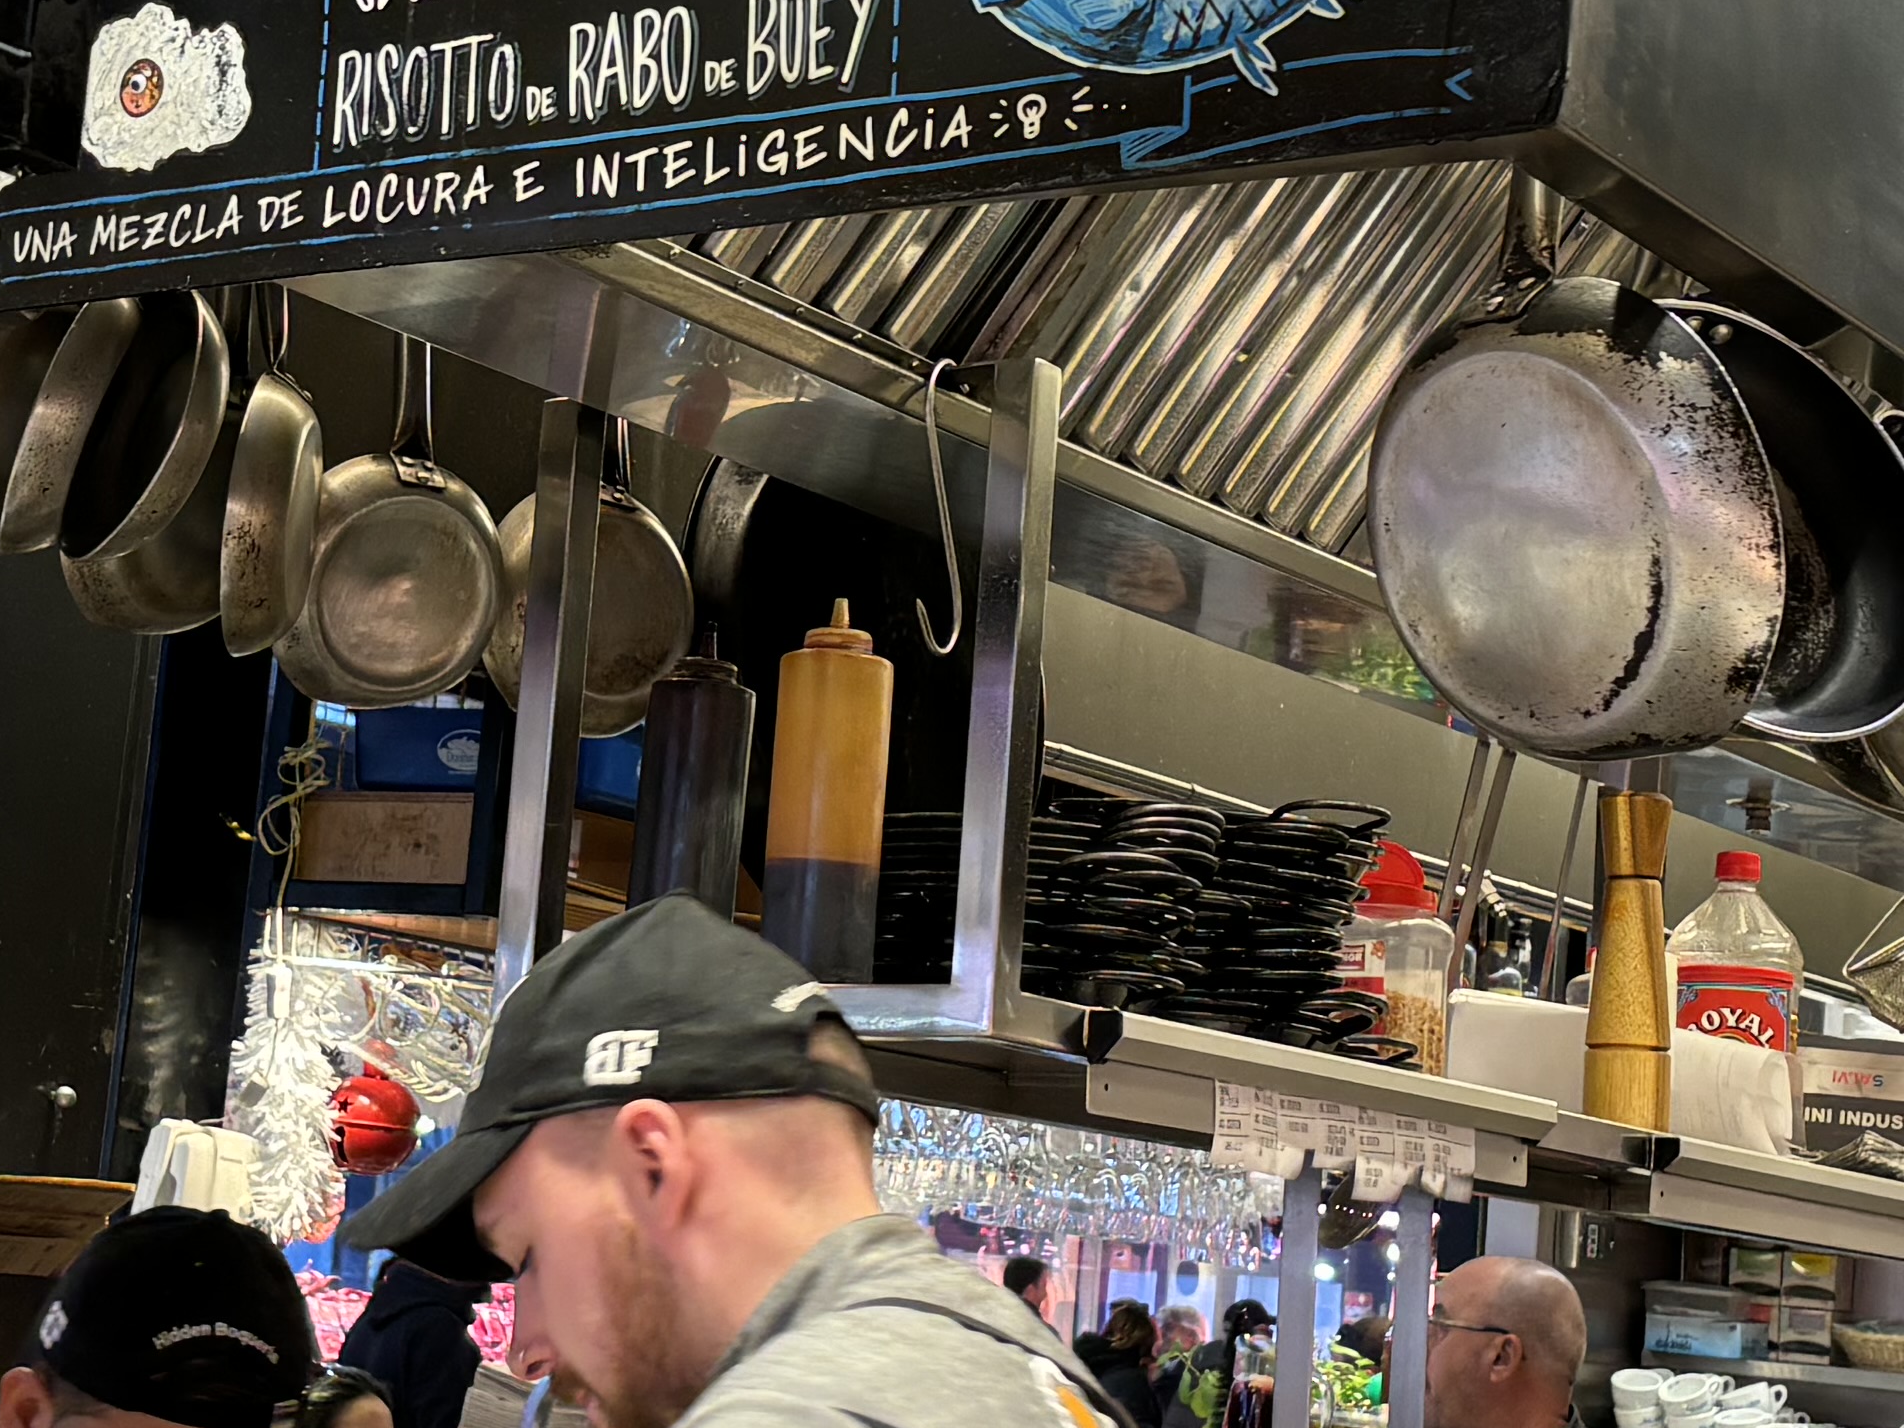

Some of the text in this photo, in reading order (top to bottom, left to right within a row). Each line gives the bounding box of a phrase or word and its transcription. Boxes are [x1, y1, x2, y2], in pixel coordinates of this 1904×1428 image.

[333, 32, 520, 151] RISOTTO
[526, 84, 558, 125] DE
[568, 5, 696, 121] RABO
[704, 57, 741, 95] DE
[13, 220, 77, 264] UNA
[90, 188, 243, 255] MEZCLA
[259, 192, 304, 230] DE
[323, 166, 495, 228] LOCURA
[514, 158, 545, 200] E
